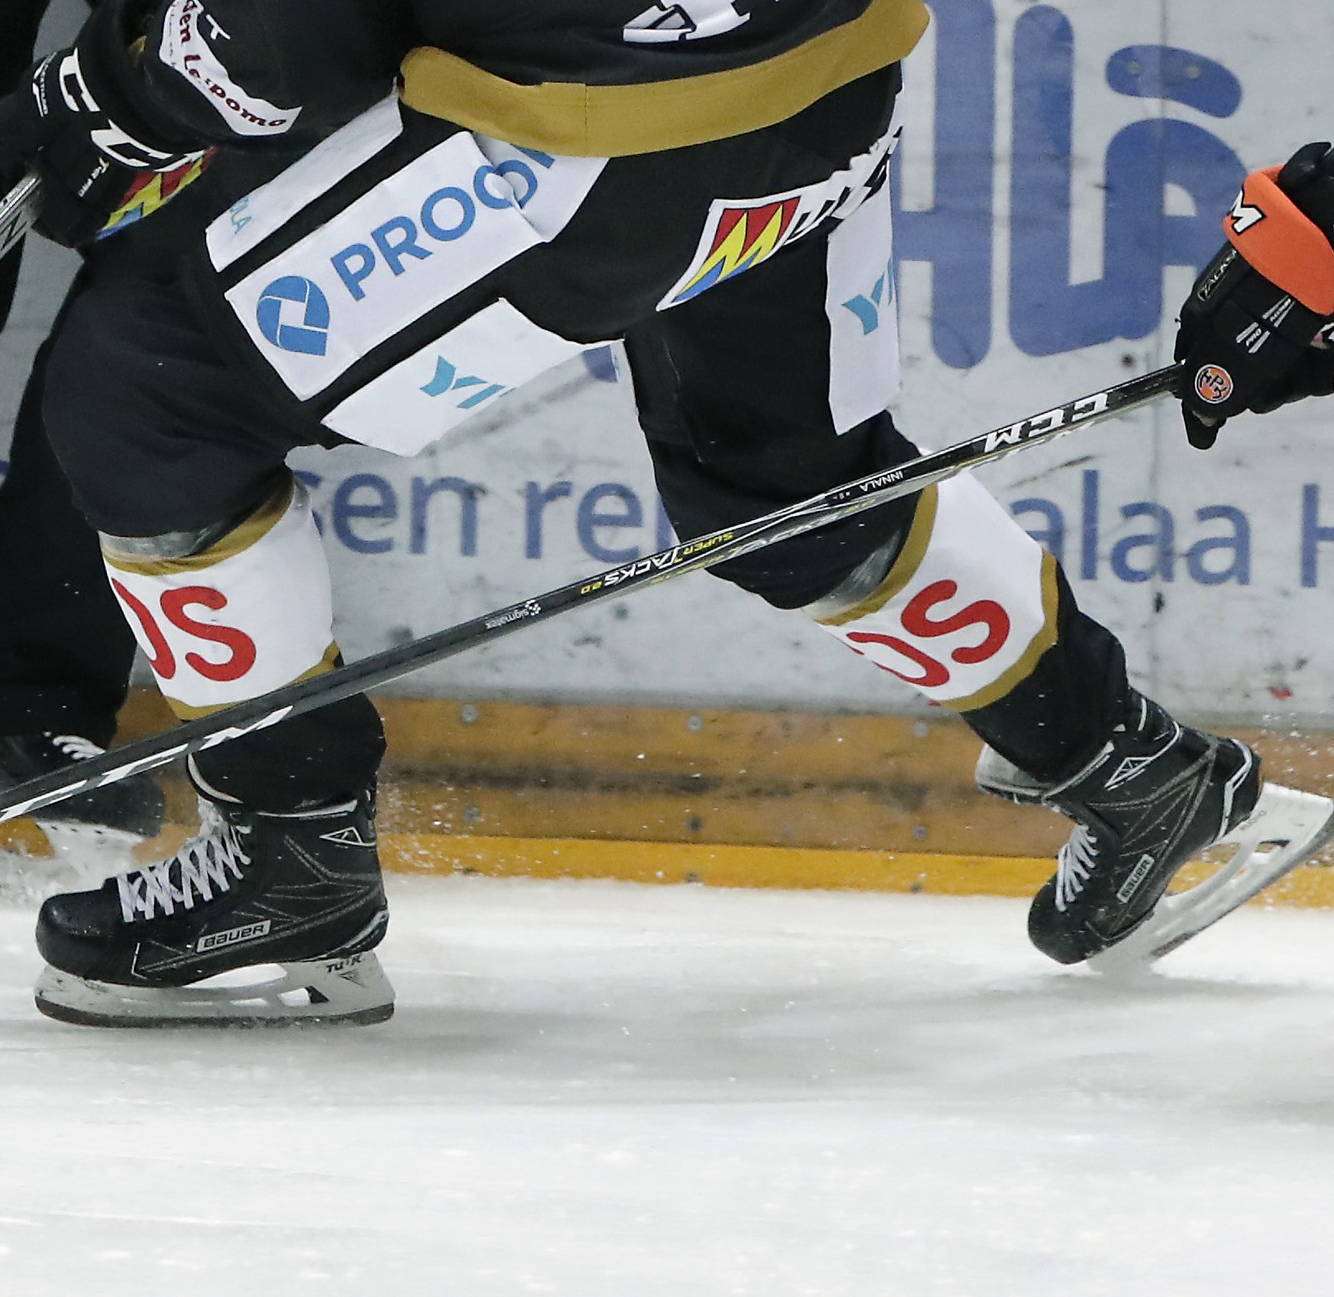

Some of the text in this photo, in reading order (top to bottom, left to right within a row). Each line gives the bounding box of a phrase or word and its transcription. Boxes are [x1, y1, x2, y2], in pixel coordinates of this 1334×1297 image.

[984, 392, 1111, 454] CCM
[859, 471, 905, 493] INNALA
[682, 531, 735, 556] SUPER
[604, 546, 685, 588] TACKS
[485, 606, 530, 630] sigmatex
[203, 923, 265, 949] BAUER
